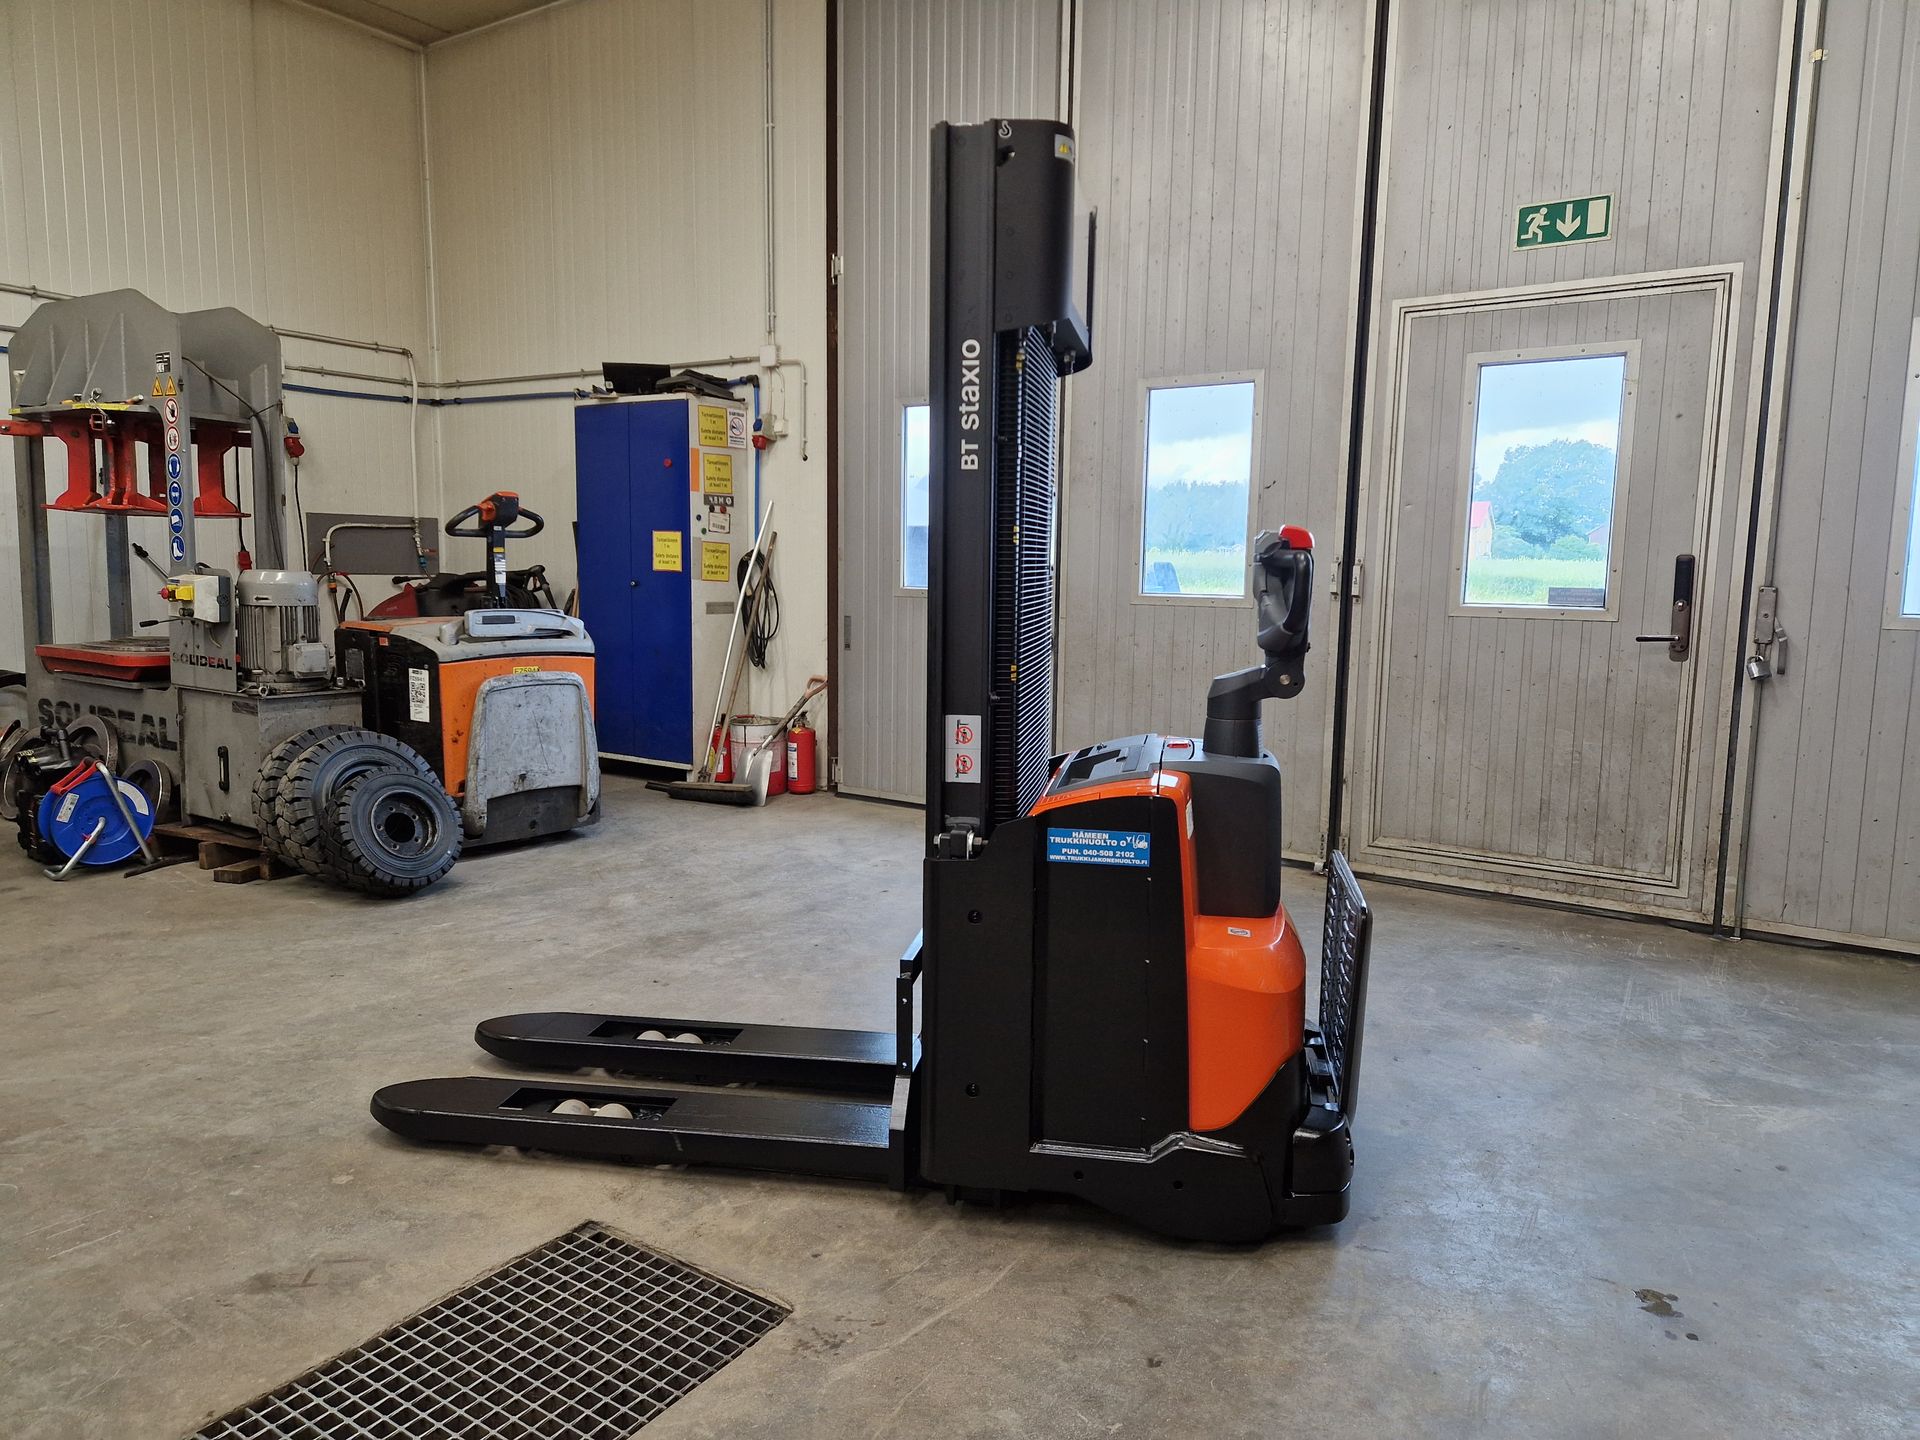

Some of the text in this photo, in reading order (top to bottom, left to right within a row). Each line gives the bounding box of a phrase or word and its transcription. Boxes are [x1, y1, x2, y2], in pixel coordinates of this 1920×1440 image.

[960, 439, 978, 470] BT
[172, 652, 232, 670] SOLIDEAL
[38, 698, 178, 752] SOEAL
[1050, 836, 1118, 846] TRUKKIHUOLTO
[1050, 854, 1148, 865] WWW.TRUKKIJAKONEHUOLTO.FI
[1083, 849, 1114, 857] 040-508
